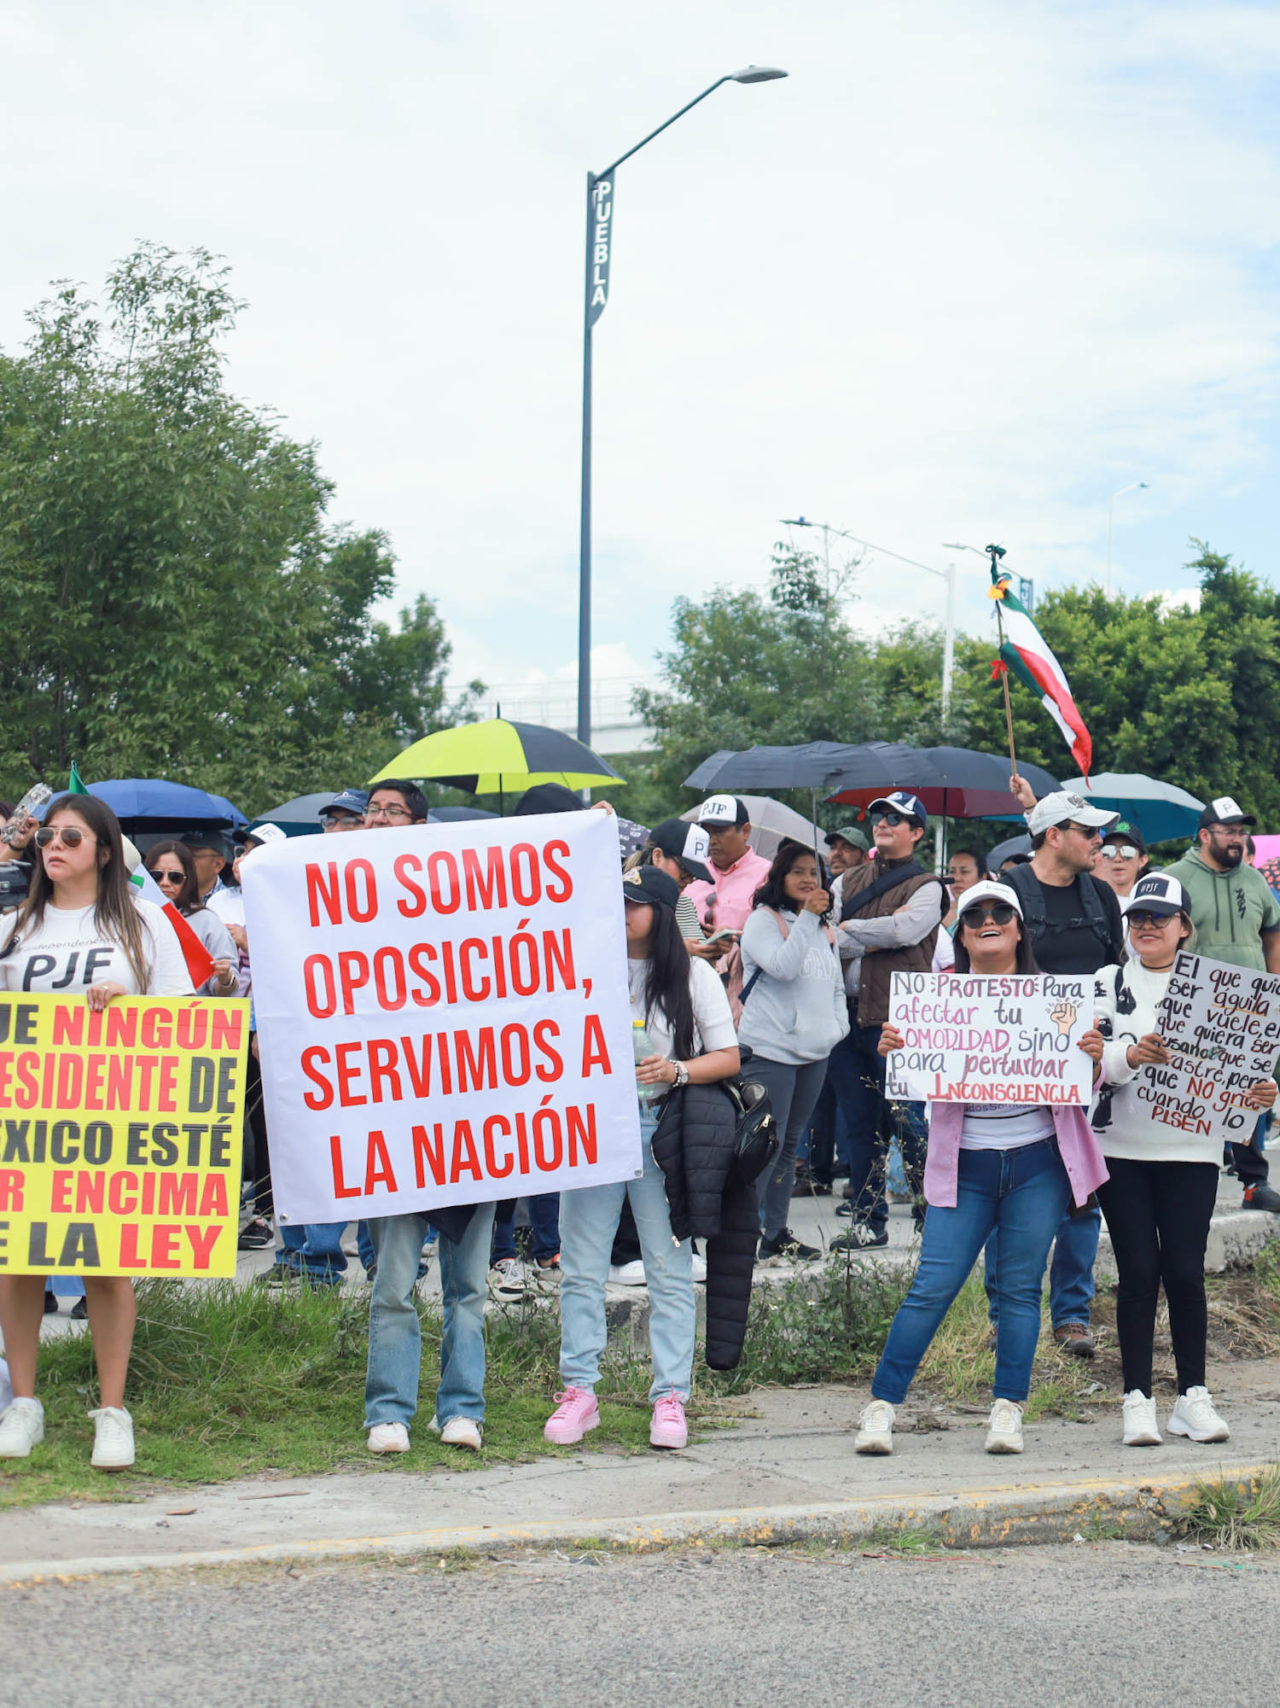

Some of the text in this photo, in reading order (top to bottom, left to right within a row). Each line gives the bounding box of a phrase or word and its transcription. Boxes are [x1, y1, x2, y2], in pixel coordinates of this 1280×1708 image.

[592, 181, 612, 306] PUEBLA
[305, 839, 574, 927] NO SOMOS
[23, 947, 114, 992] PJF
[303, 918, 593, 1019] OPOSICIÓN,
[937, 975, 1036, 998] PROTESTO
[1175, 954, 1200, 979] El
[1209, 969, 1241, 992] que
[895, 997, 1023, 1025] afectar tu
[1162, 997, 1192, 1022] que
[1168, 978, 1269, 1016] ser águila
[52, 1001, 243, 1050] NINGÚN
[905, 1027, 1070, 1055] OMODIDAD, sino
[1158, 1016, 1280, 1055] que quiera ser
[301, 1014, 612, 1111] SERVIMOS A
[890, 1051, 1069, 1084] para perturbar
[1154, 1036, 1273, 1073] usano que se
[0, 1051, 238, 1114] ESIDENTE DE
[886, 1072, 909, 1097] tu
[1145, 1066, 1178, 1089] que
[1186, 1077, 1214, 1099] NO
[1137, 1086, 1245, 1129] cuando lo
[1151, 1105, 1212, 1136] PISEN
[0, 1116, 232, 1167] XICO ESTÉ
[329, 1094, 598, 1199] LA NACIÓN
[50, 1170, 229, 1217] ENCIMA
[28, 1222, 101, 1267] LA
[118, 1223, 223, 1270] LEY
